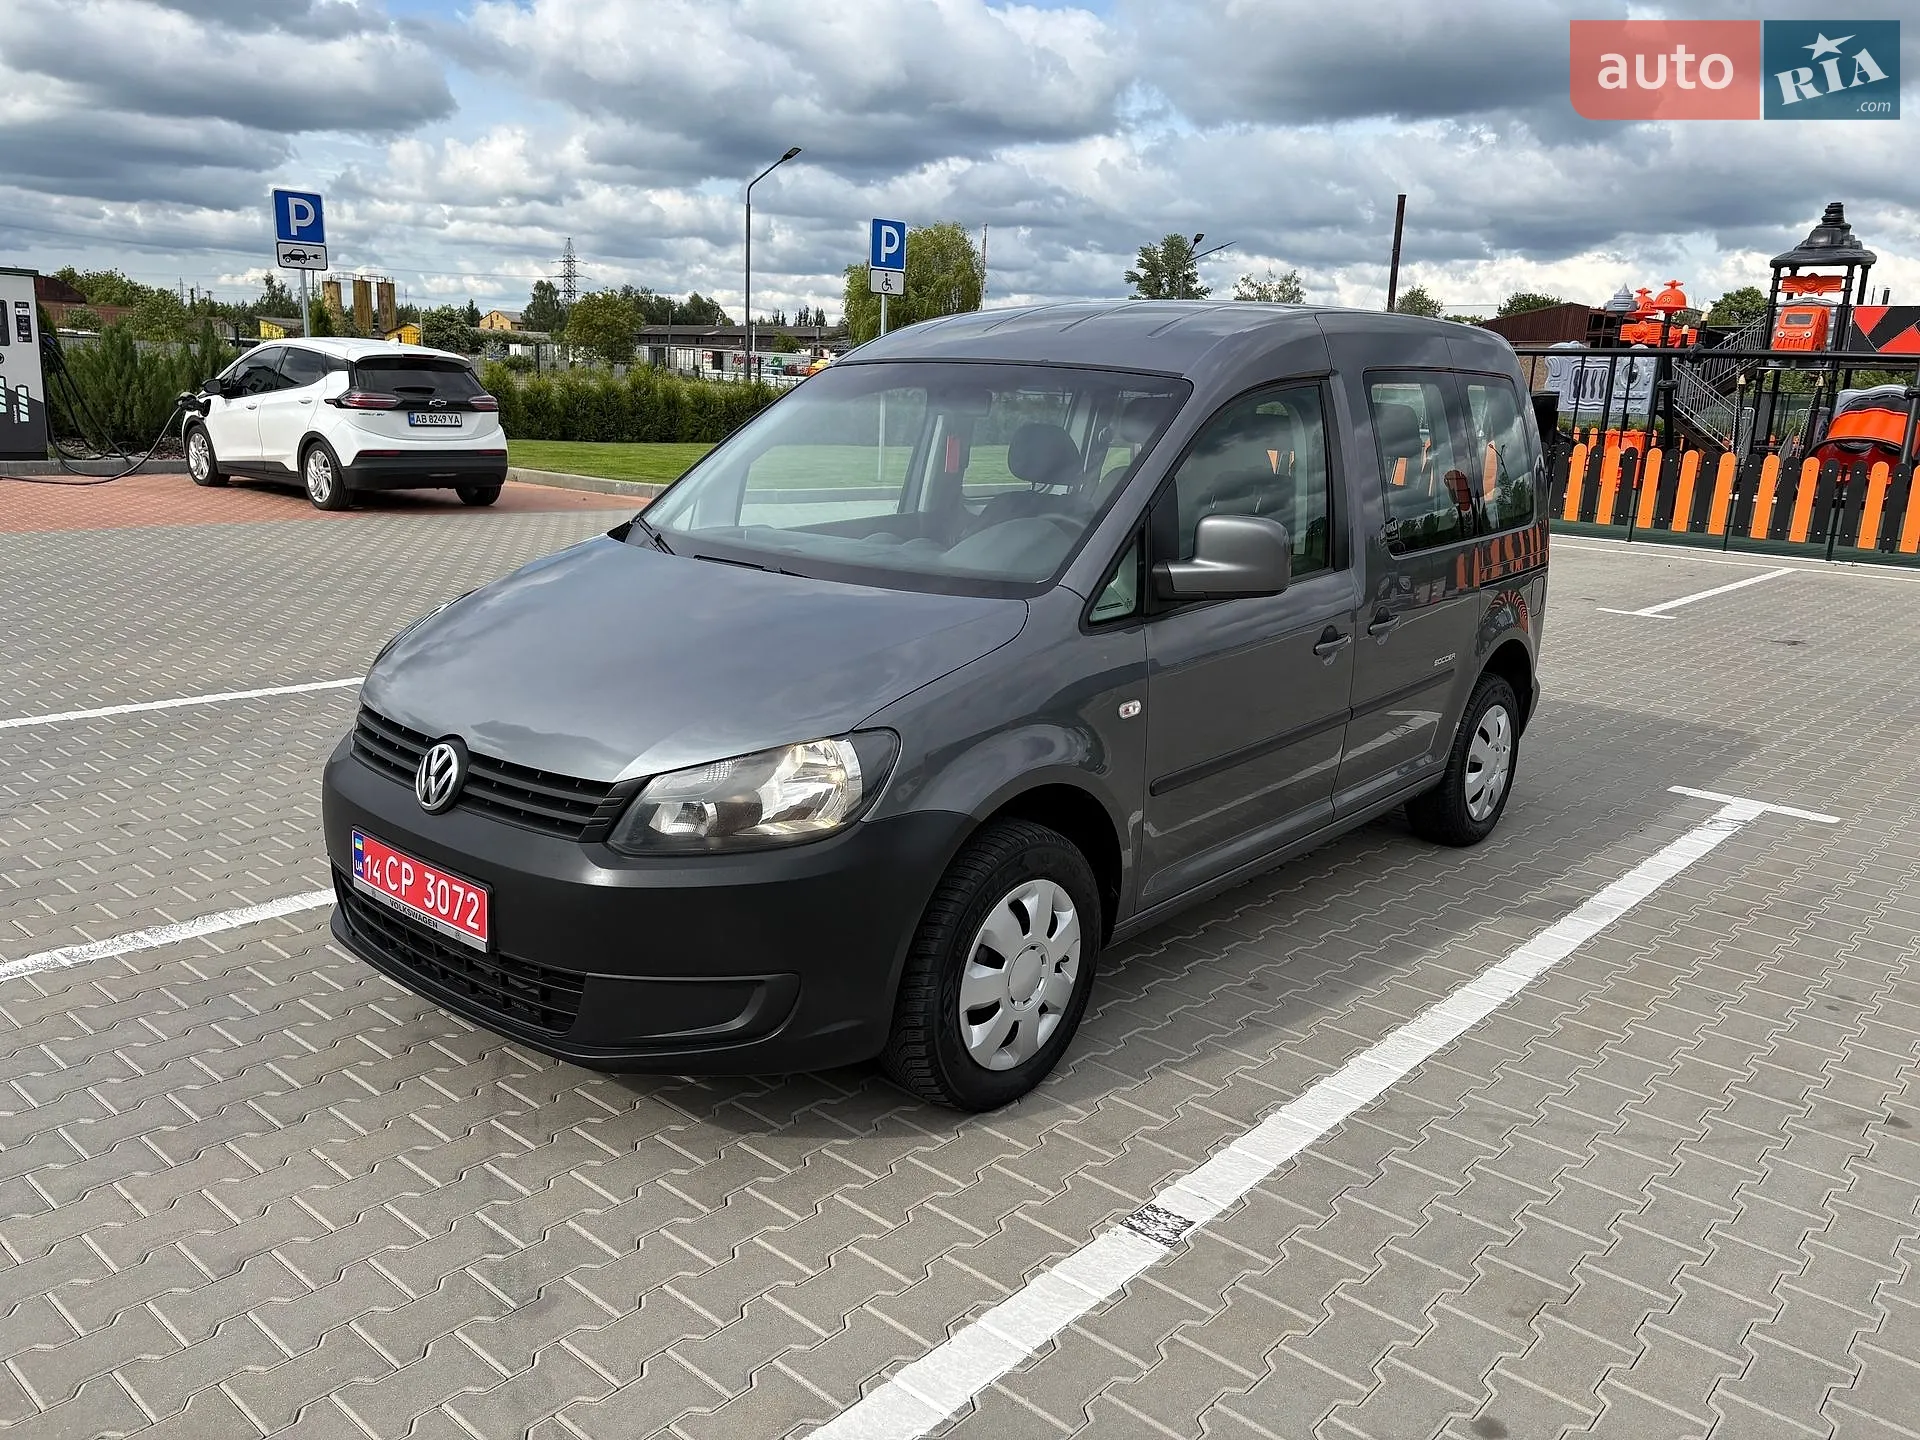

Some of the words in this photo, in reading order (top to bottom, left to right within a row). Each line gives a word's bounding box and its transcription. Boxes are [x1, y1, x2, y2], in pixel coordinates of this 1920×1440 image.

[287, 197, 315, 236] P
[880, 225, 900, 263] P
[415, 415, 428, 424] AB
[429, 414, 447, 424] 8249
[447, 415, 460, 424] YA
[355, 859, 364, 873] UA
[364, 854, 381, 885] 14
[385, 855, 415, 897] CP
[423, 871, 480, 931] 3072
[389, 898, 438, 929] VOLKSWAGEN
